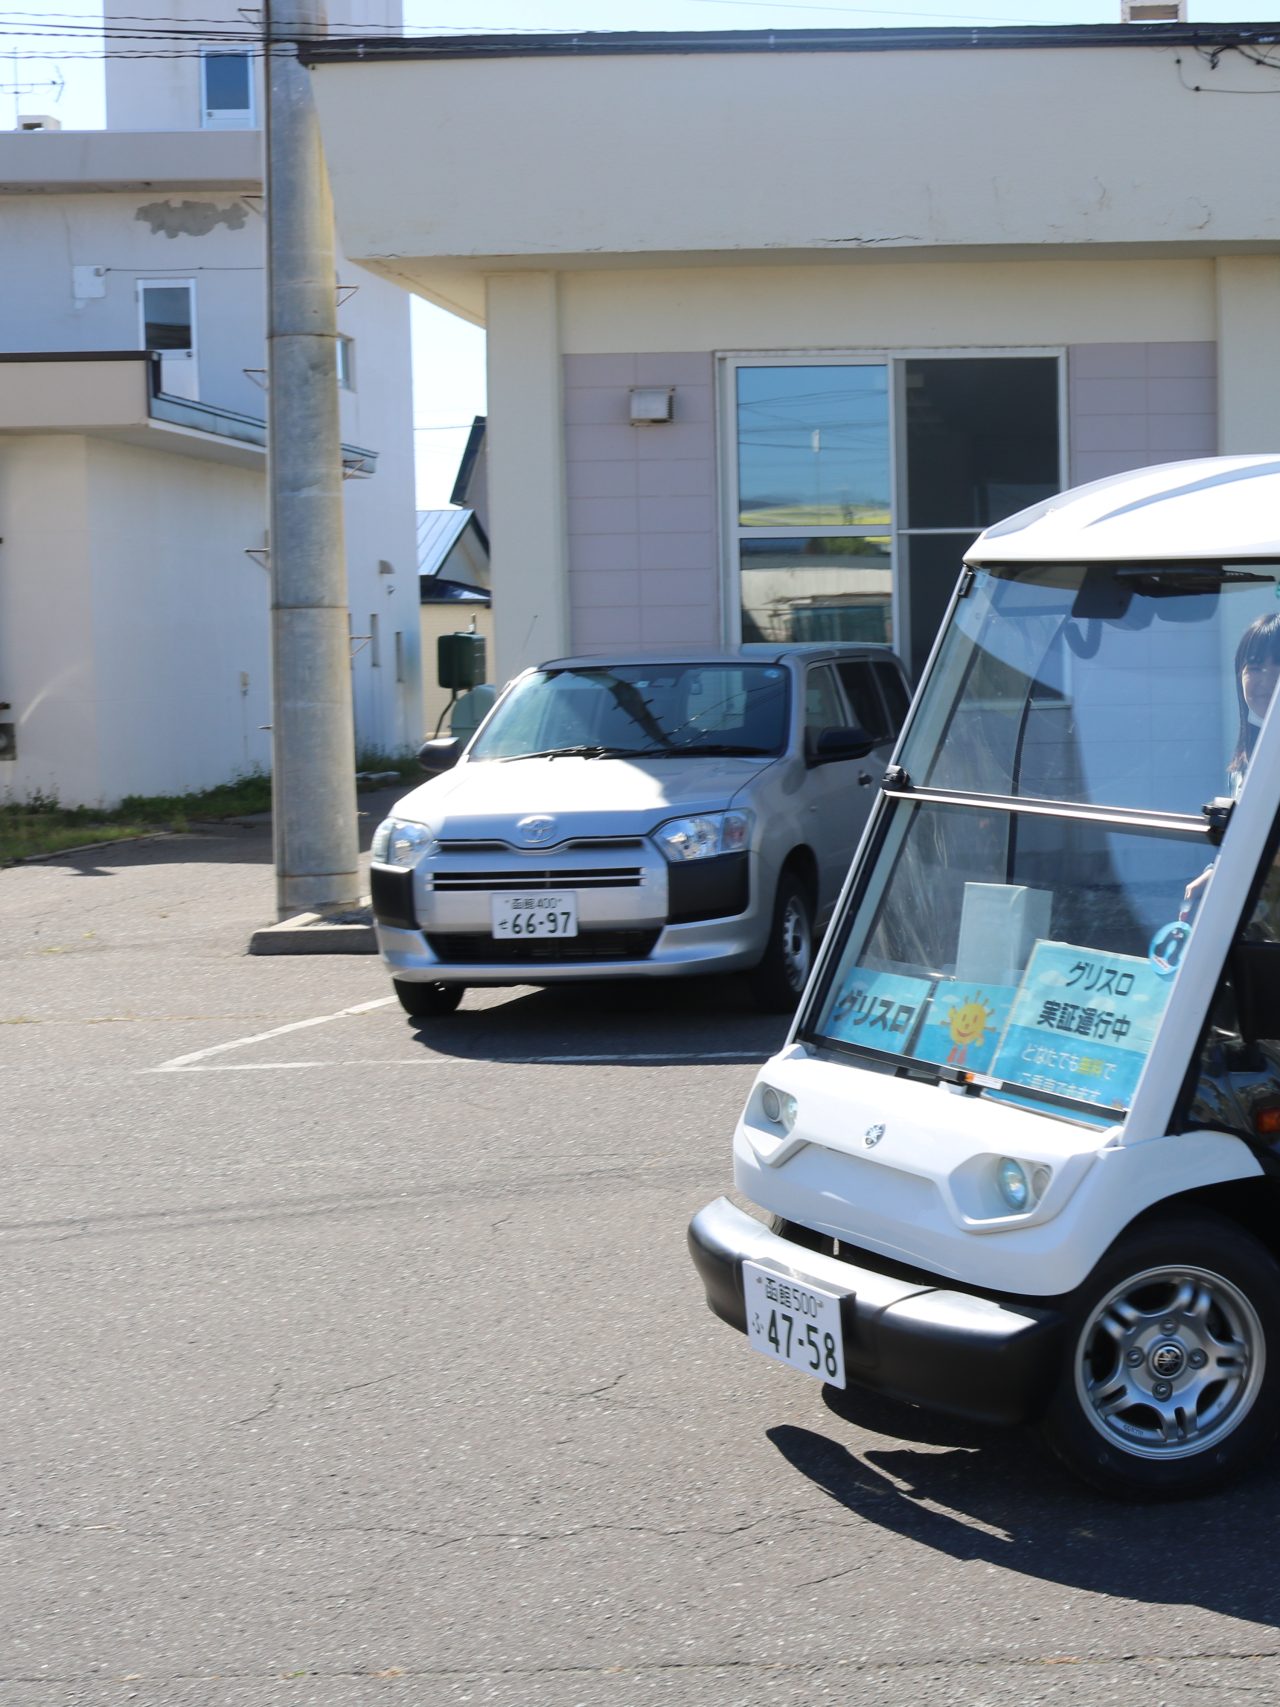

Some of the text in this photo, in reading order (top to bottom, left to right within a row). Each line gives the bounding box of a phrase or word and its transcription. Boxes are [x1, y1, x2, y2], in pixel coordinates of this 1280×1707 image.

[512, 912, 571, 934] 66-97
[1066, 961, 1135, 996] グリスロ
[833, 989, 917, 1035] グリスロ
[1037, 1000, 1131, 1042] 実証運行中
[768, 1309, 837, 1377] 47-58
